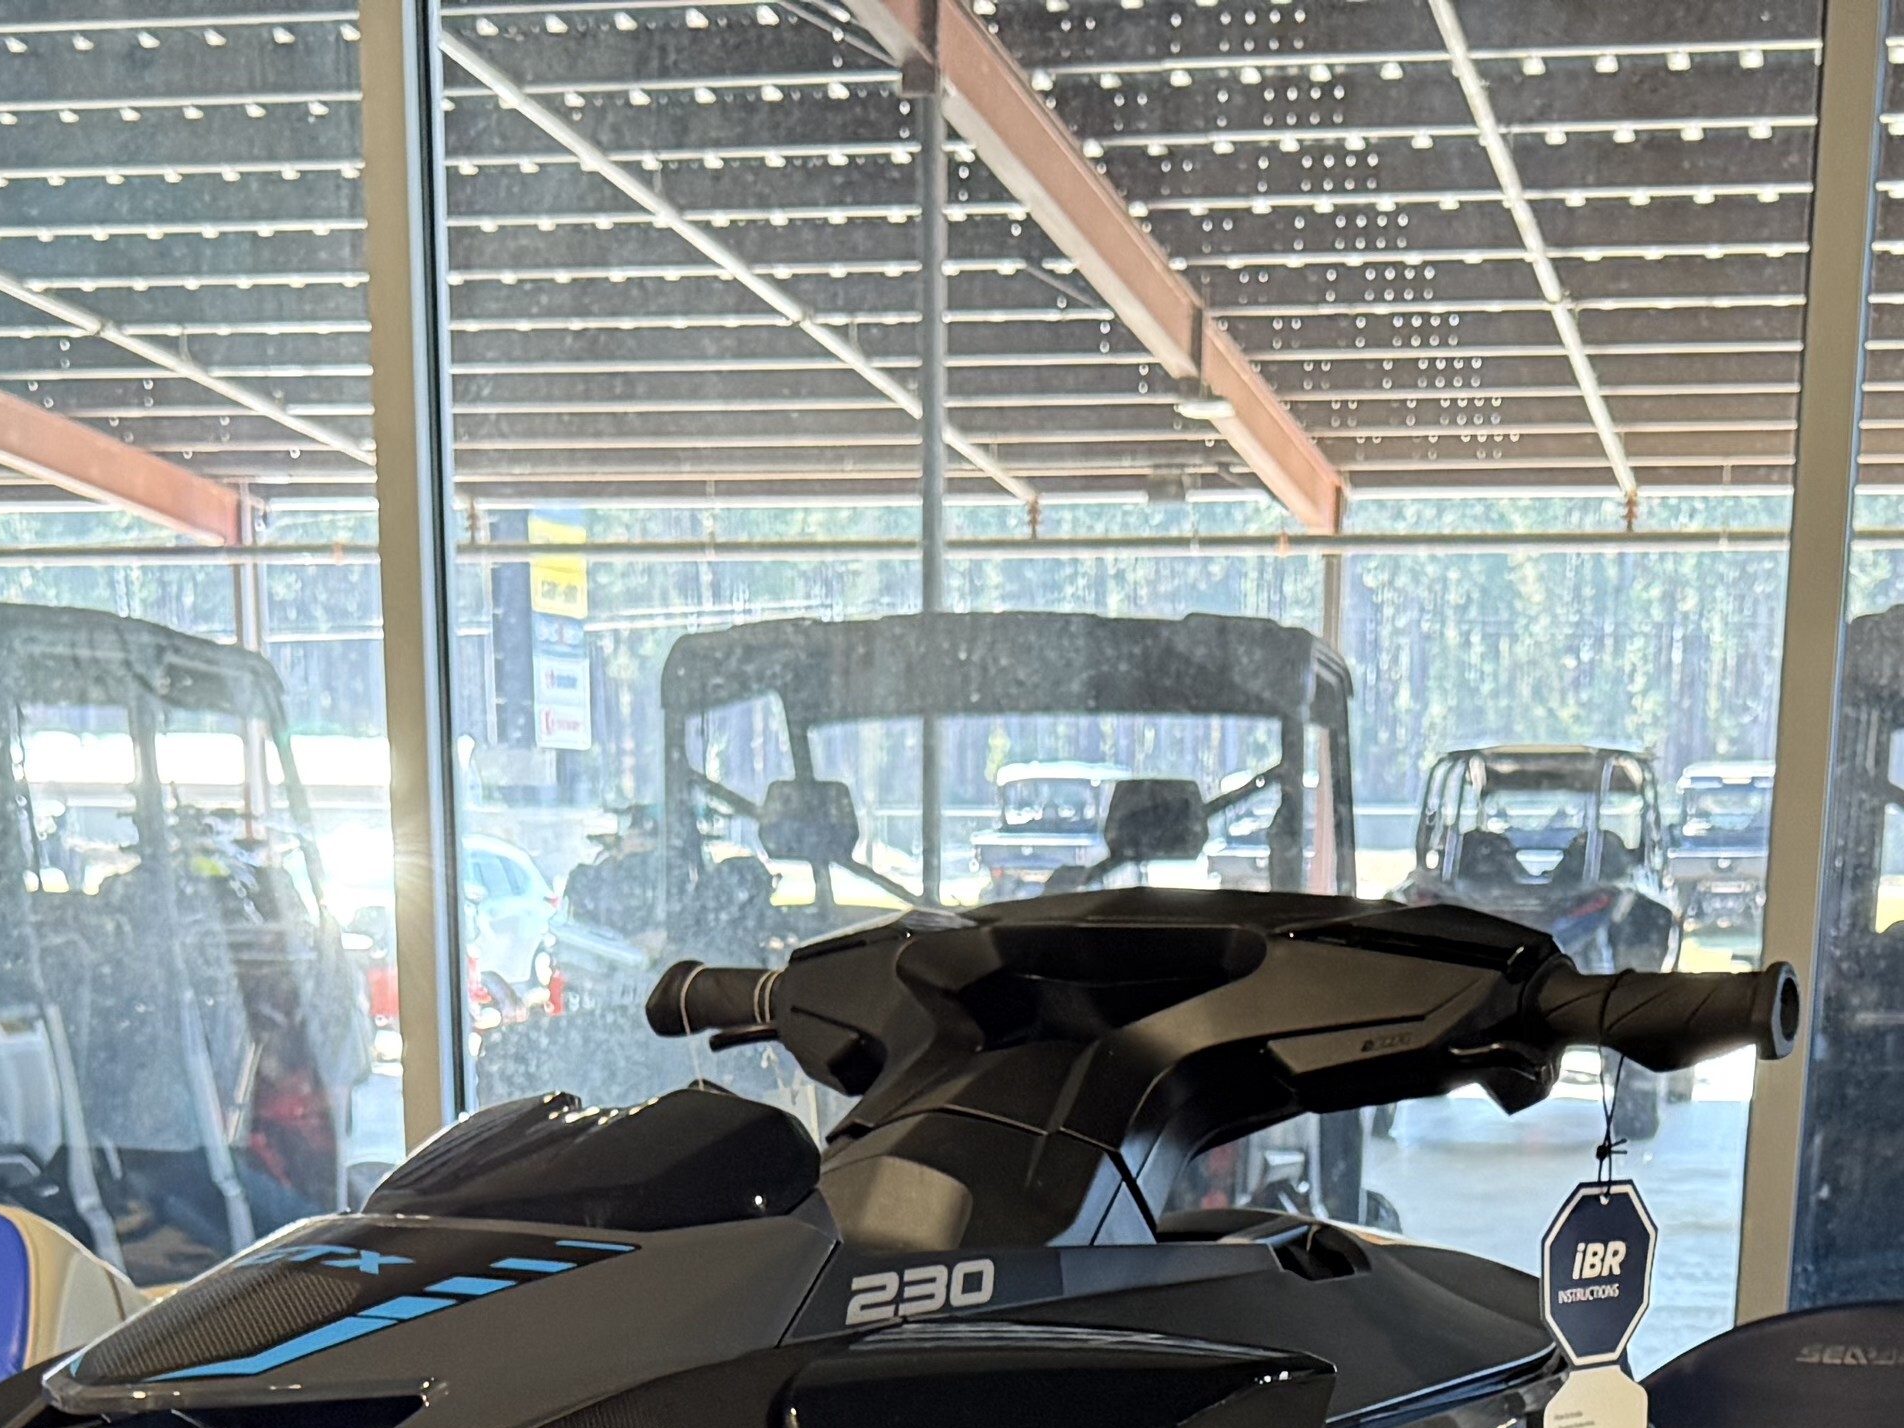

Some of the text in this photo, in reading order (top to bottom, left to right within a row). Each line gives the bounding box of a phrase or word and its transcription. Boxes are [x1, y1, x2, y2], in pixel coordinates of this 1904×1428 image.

[1572, 1240, 1627, 1280] iBR
[845, 1257, 995, 1326] 230
[1558, 1283, 1620, 1304] INSTRUCTIONS
